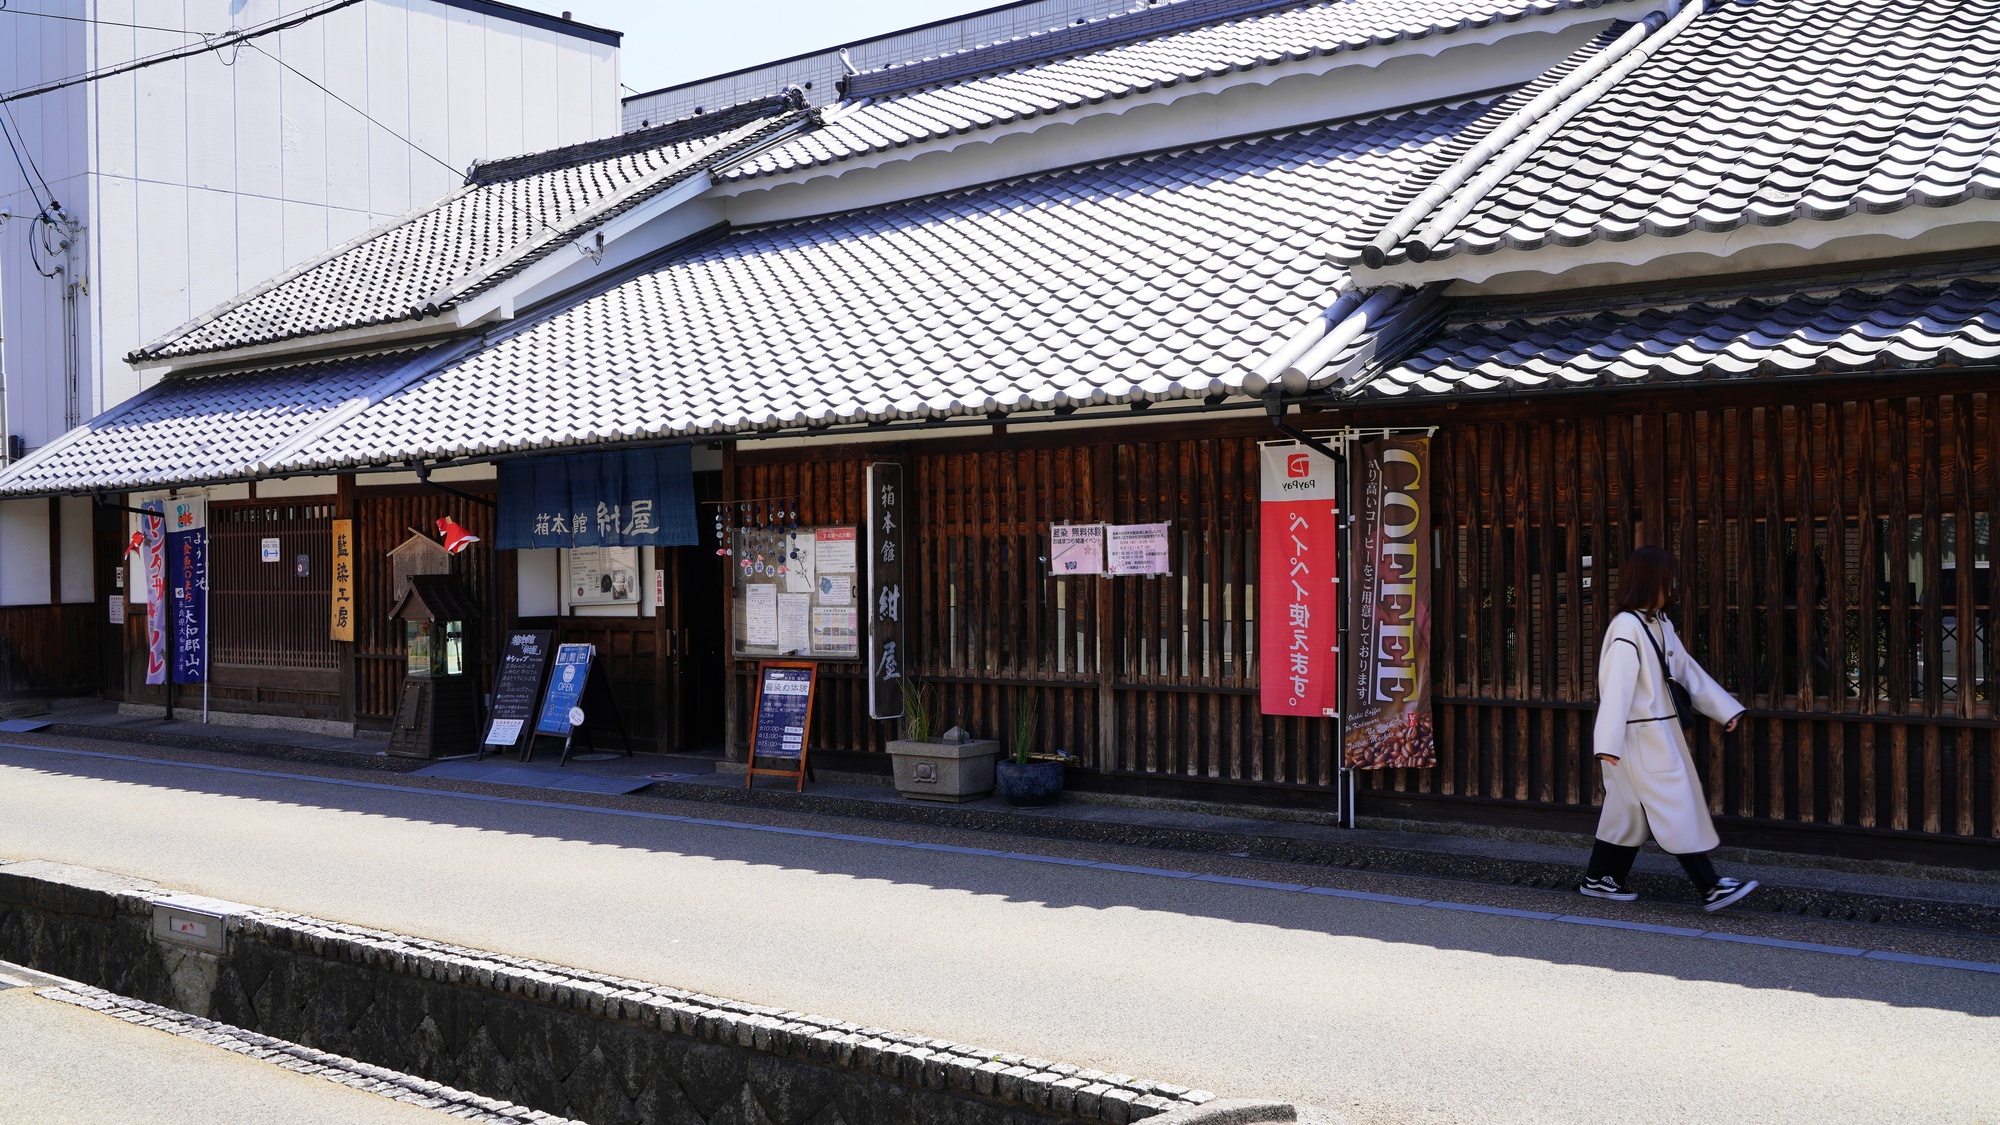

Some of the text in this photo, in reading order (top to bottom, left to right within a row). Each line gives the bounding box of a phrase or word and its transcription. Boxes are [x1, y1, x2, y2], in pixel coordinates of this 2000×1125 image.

[533, 512, 588, 538] 箱本館
[193, 532, 205, 590] ようこそ
[337, 534, 350, 628] 藍染工房
[876, 485, 901, 682] 箱本館 紺屋
[1376, 449, 1421, 702] COFFEE
[557, 682, 575, 692] OPEN
[1364, 707, 1381, 718] Coffee
